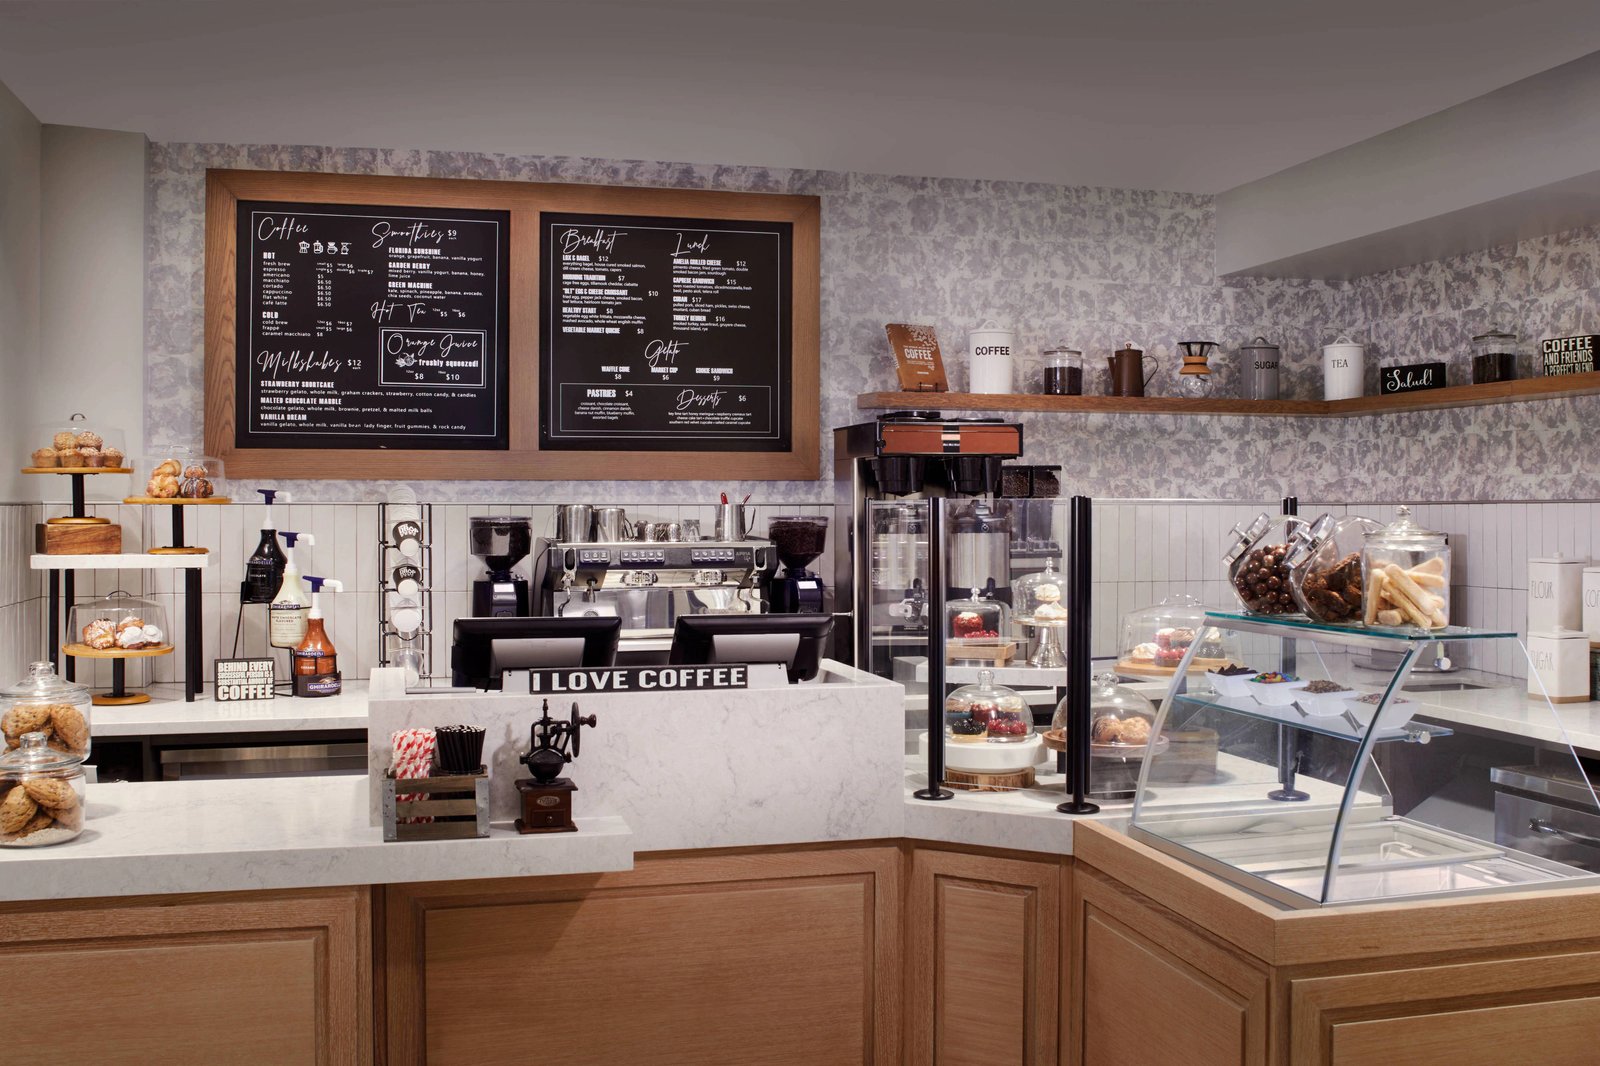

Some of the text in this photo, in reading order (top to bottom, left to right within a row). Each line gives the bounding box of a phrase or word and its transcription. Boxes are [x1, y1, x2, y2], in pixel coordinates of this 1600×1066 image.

[258, 217, 309, 241] Coffee
[371, 221, 444, 249] Smoothies
[448, 229, 457, 237] $9
[560, 229, 628, 254] Breakfast
[670, 232, 710, 257] Lunch
[262, 311, 278, 319] COLD
[370, 300, 426, 323] Hot Tea
[387, 333, 478, 358] Orange Juice
[645, 339, 689, 367] Gelato
[975, 346, 1010, 356] COFFEE
[1543, 336, 1593, 353] COFFEE
[904, 348, 933, 360] COFFEE
[1544, 349, 1593, 366] AND FRIENDS
[257, 350, 342, 379] Milkshakes
[348, 359, 362, 368] $12
[419, 359, 478, 368] freshly squeezed!
[1331, 359, 1349, 368] TEA
[445, 373, 460, 381] $10
[1386, 369, 1433, 392] Salud!
[285, 397, 317, 405] CHOCOLATE
[587, 389, 616, 398] PASTRIES
[676, 389, 727, 411] Desserts
[1531, 581, 1554, 599] FLOUR
[218, 661, 273, 672] BEHIND EVERY
[532, 667, 746, 691] I LOVE COFFEE
[218, 685, 274, 700] COFFEE
